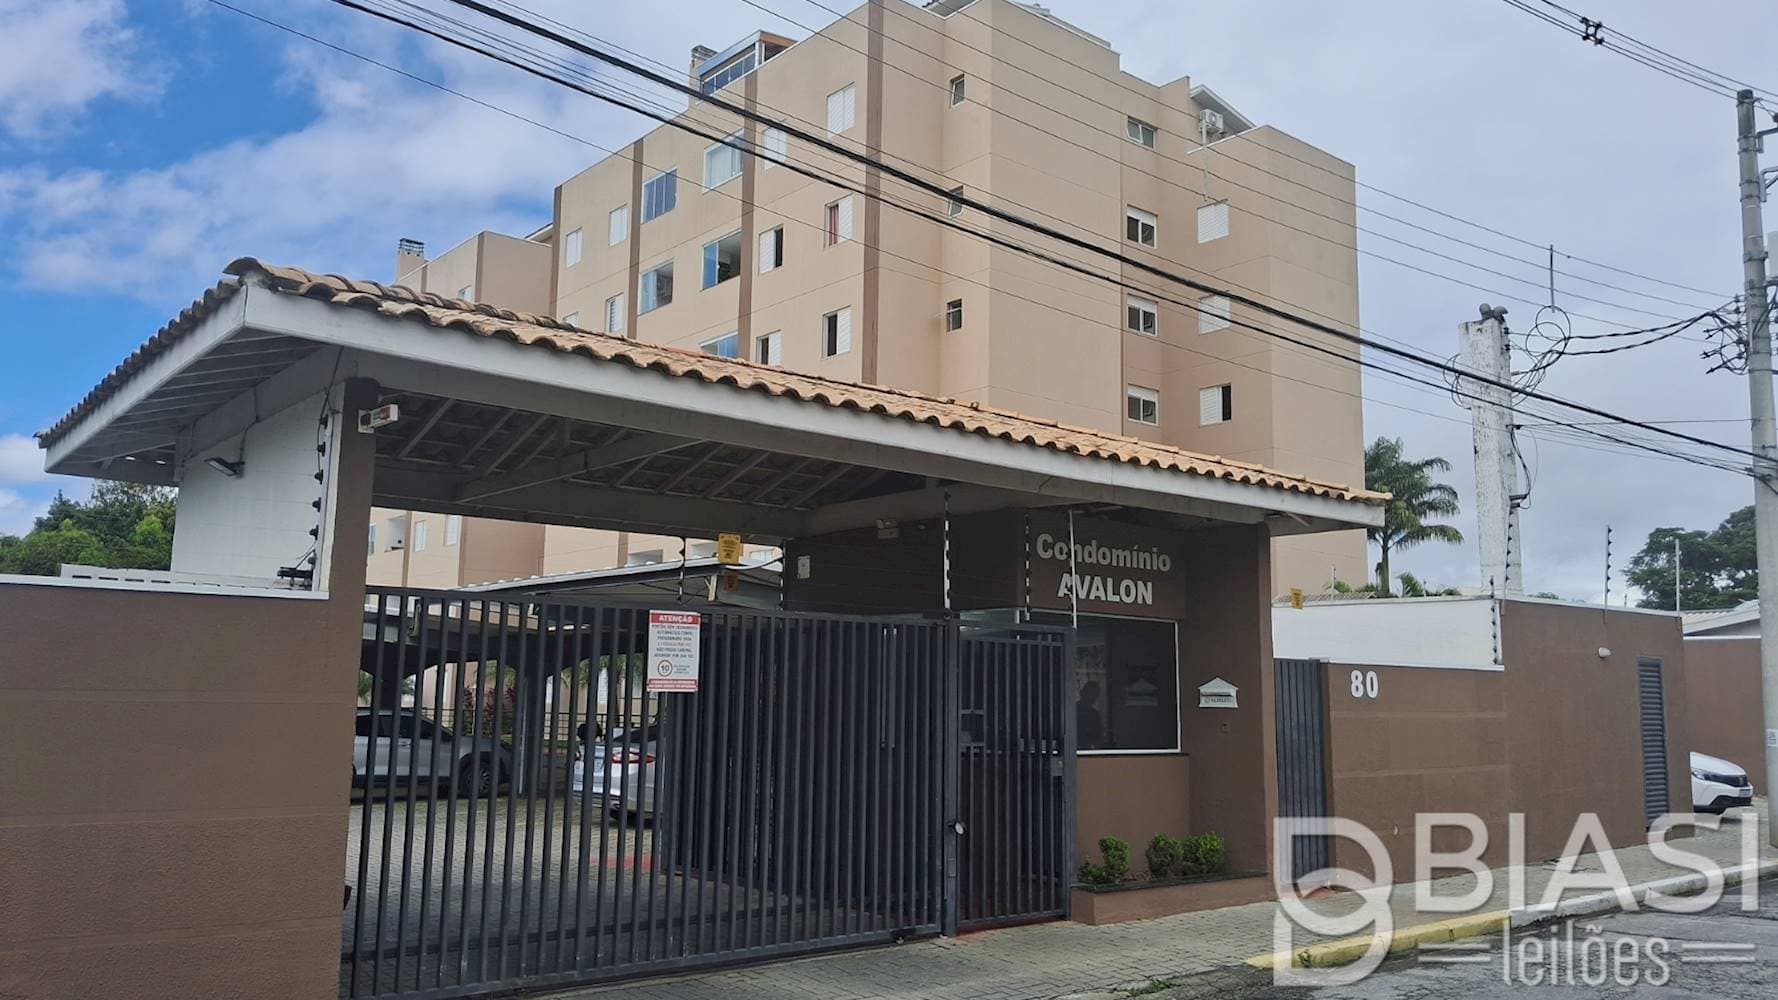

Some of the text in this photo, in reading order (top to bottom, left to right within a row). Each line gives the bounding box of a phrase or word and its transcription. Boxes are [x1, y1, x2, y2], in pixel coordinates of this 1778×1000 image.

[1036, 533, 1172, 572] Condomínio
[1057, 572, 1153, 605] AVALON
[658, 615, 693, 623] ATENÇÃO
[1350, 669, 1379, 698] 80
